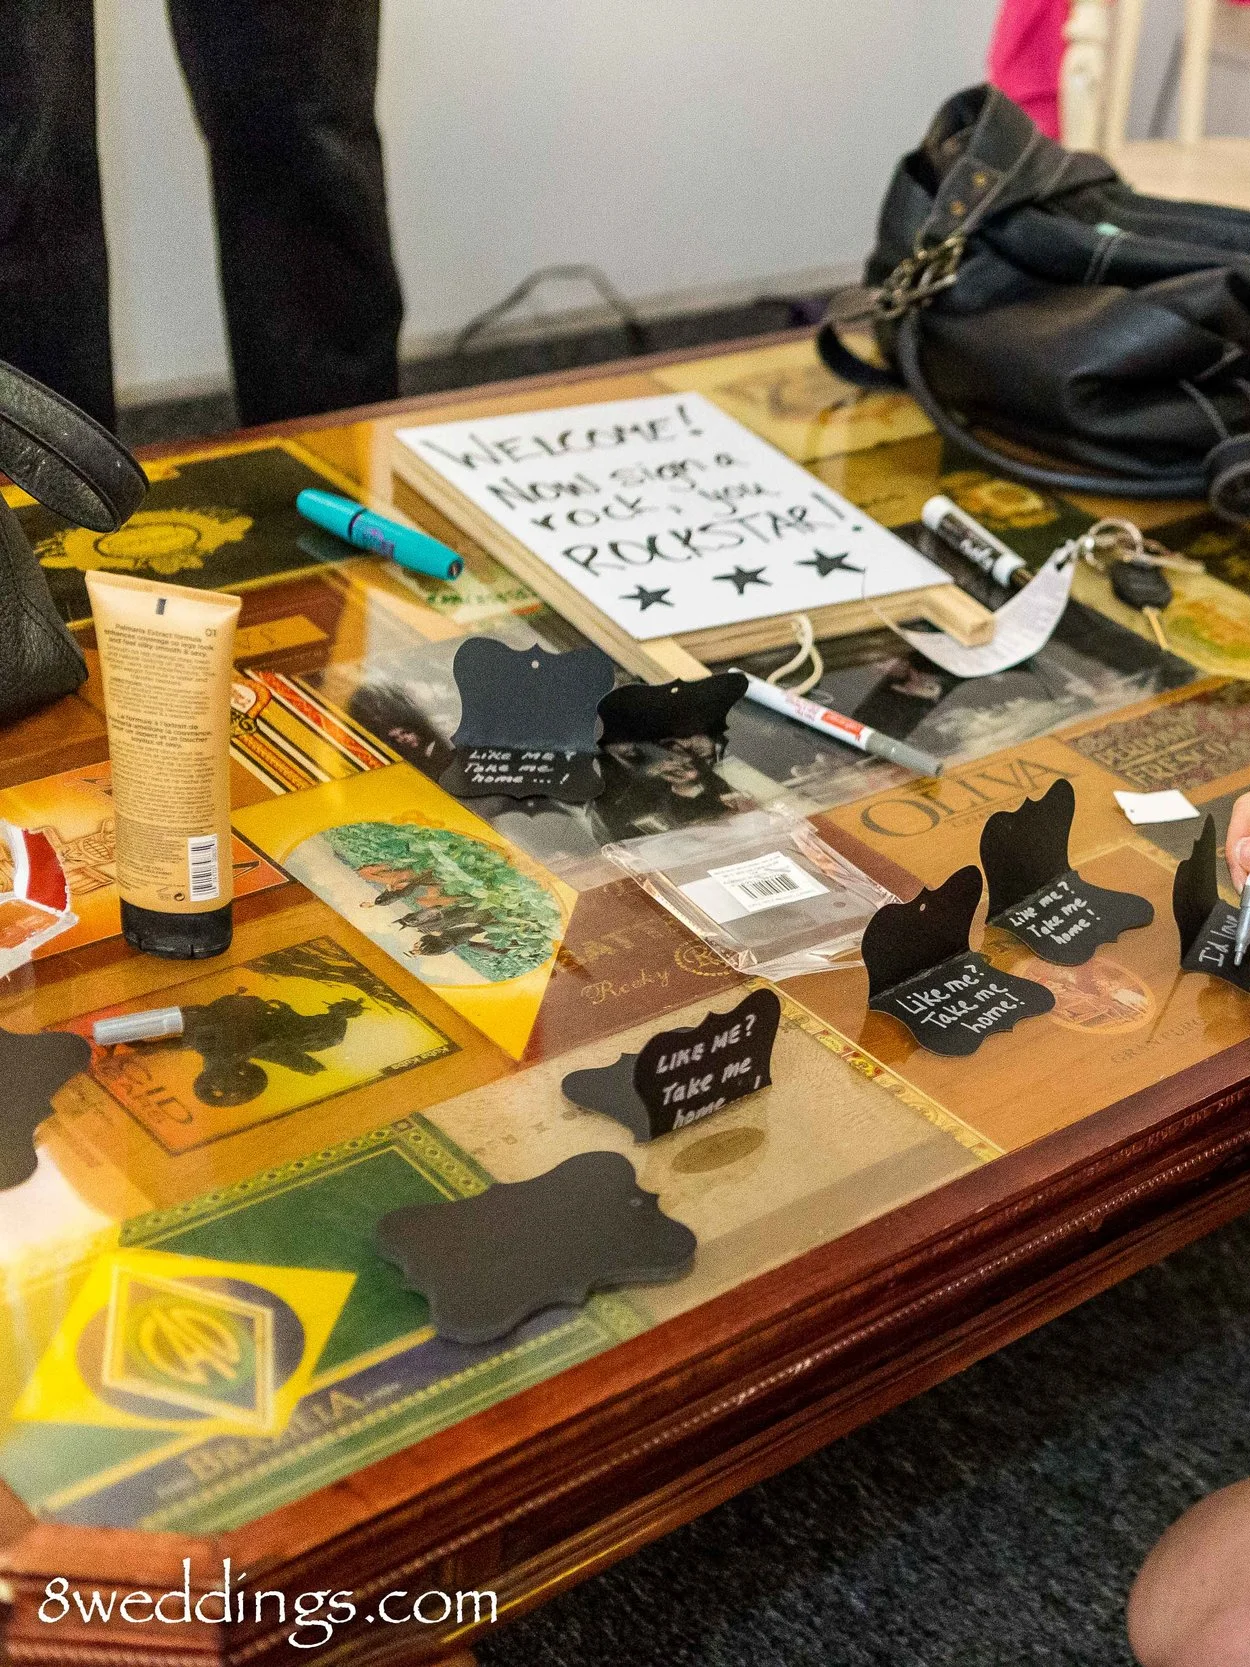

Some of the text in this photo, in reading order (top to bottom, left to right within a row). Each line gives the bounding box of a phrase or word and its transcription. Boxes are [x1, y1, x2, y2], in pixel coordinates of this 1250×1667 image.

[418, 404, 704, 470] WELCOME!
[486, 471, 602, 511] Now
[608, 458, 708, 491] sign
[697, 481, 781, 517] you
[561, 491, 863, 577] ROCKSTAR!
[859, 758, 1080, 838] OLIVA
[1026, 898, 1088, 938] Take me
[895, 988, 952, 1015] Like
[920, 983, 1009, 1029] Take me
[655, 1042, 706, 1075] LIKE
[662, 1056, 752, 1106] Take me
